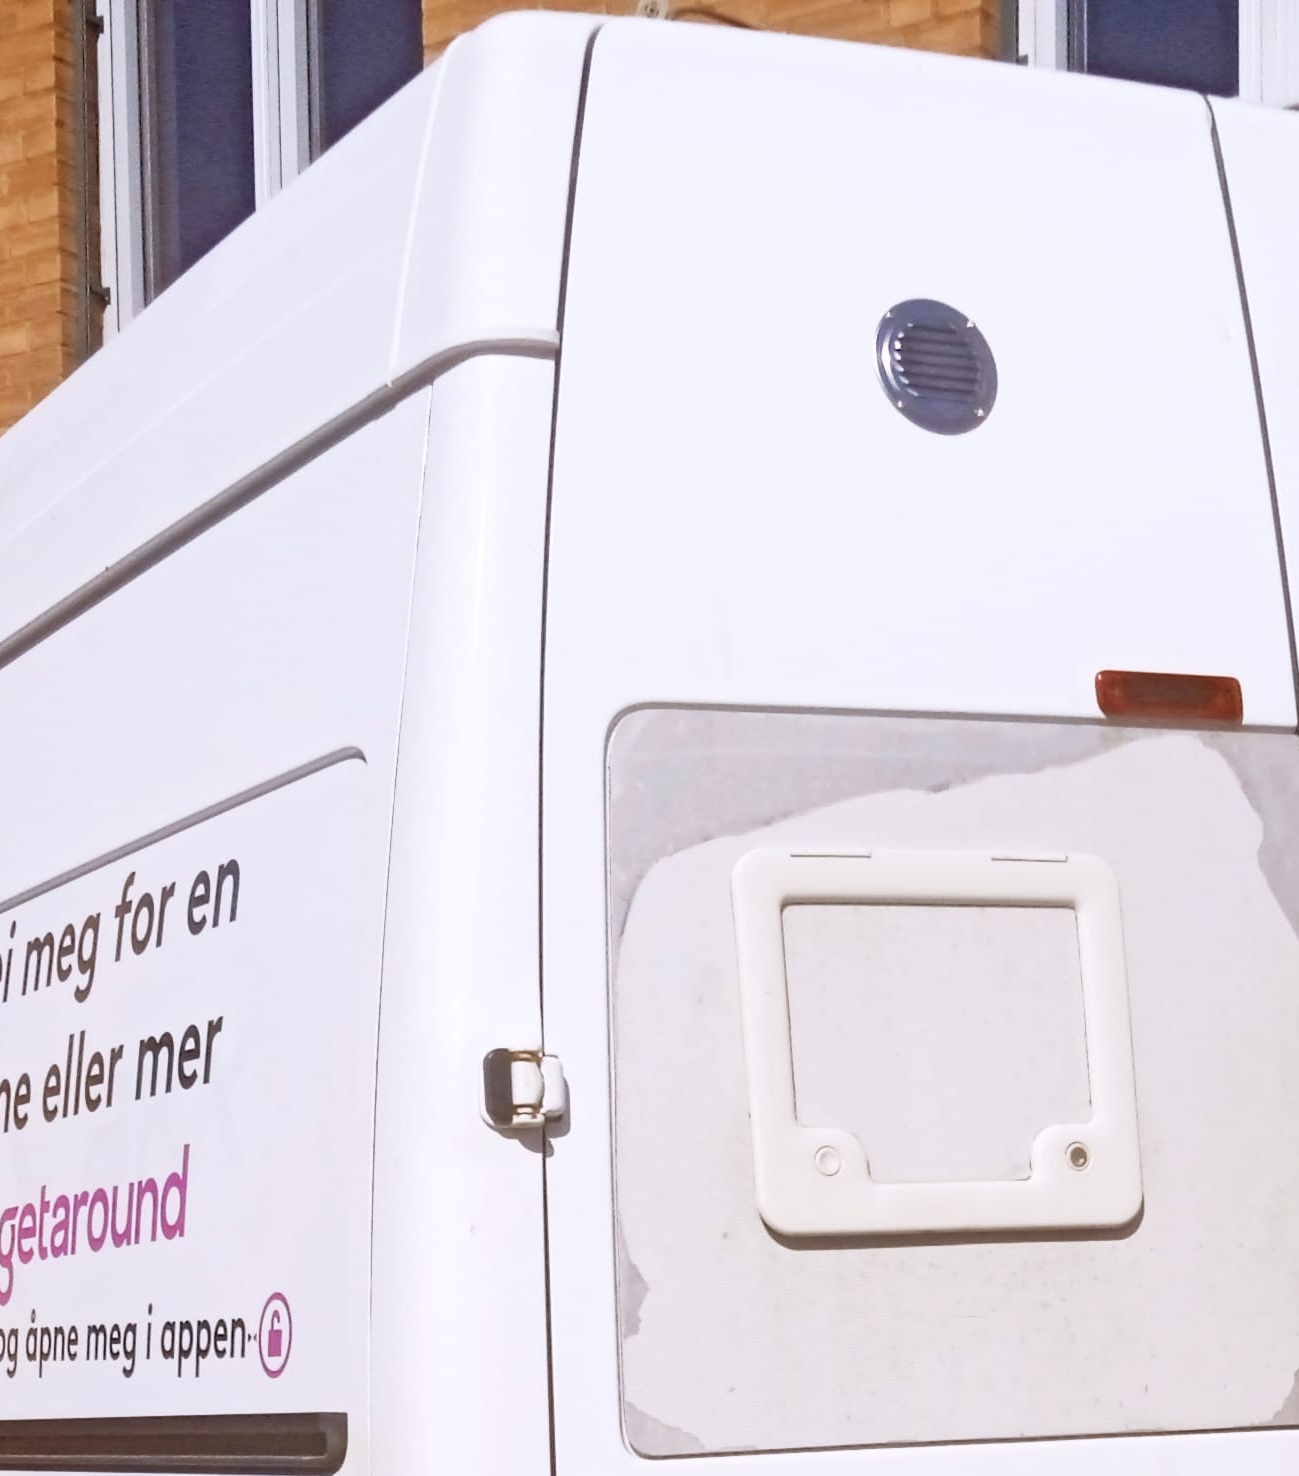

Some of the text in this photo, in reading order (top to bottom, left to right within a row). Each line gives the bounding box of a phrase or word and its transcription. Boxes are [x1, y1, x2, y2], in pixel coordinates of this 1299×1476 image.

[21, 911, 101, 1003] meg
[114, 871, 177, 963] for
[187, 858, 241, 936] en
[42, 1030, 125, 1123] eller
[135, 1015, 224, 1100] mer
[26, 1308, 79, 1379] åpne
[86, 1317, 138, 1379] meg
[145, 1303, 154, 1360] i
[160, 1311, 247, 1379] appen
